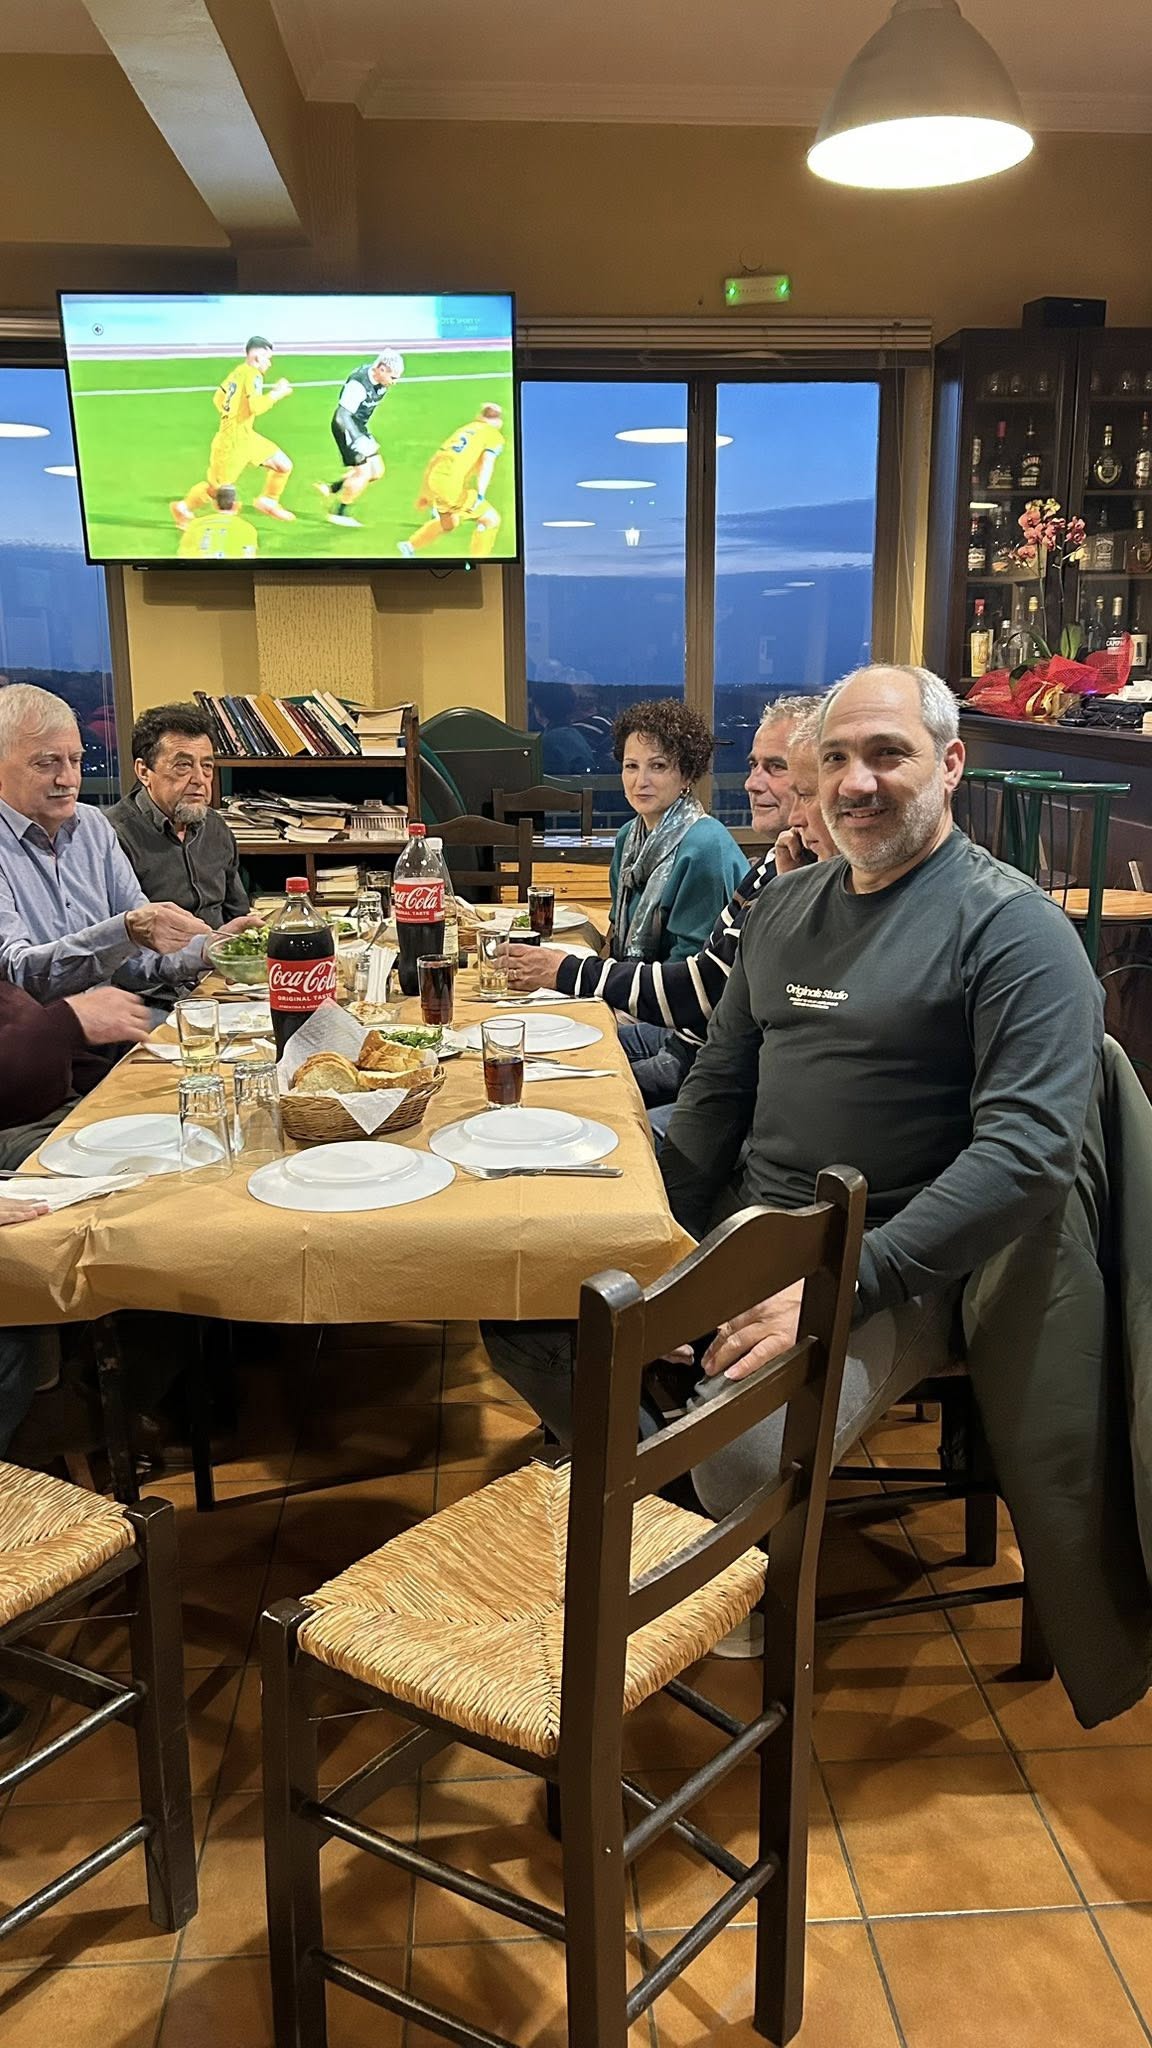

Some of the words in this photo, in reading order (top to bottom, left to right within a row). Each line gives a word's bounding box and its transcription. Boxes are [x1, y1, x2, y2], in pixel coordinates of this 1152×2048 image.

[269, 960, 337, 994] Coca-Cola
[786, 983, 823, 998] Originals
[821, 989, 849, 1001] Studio
